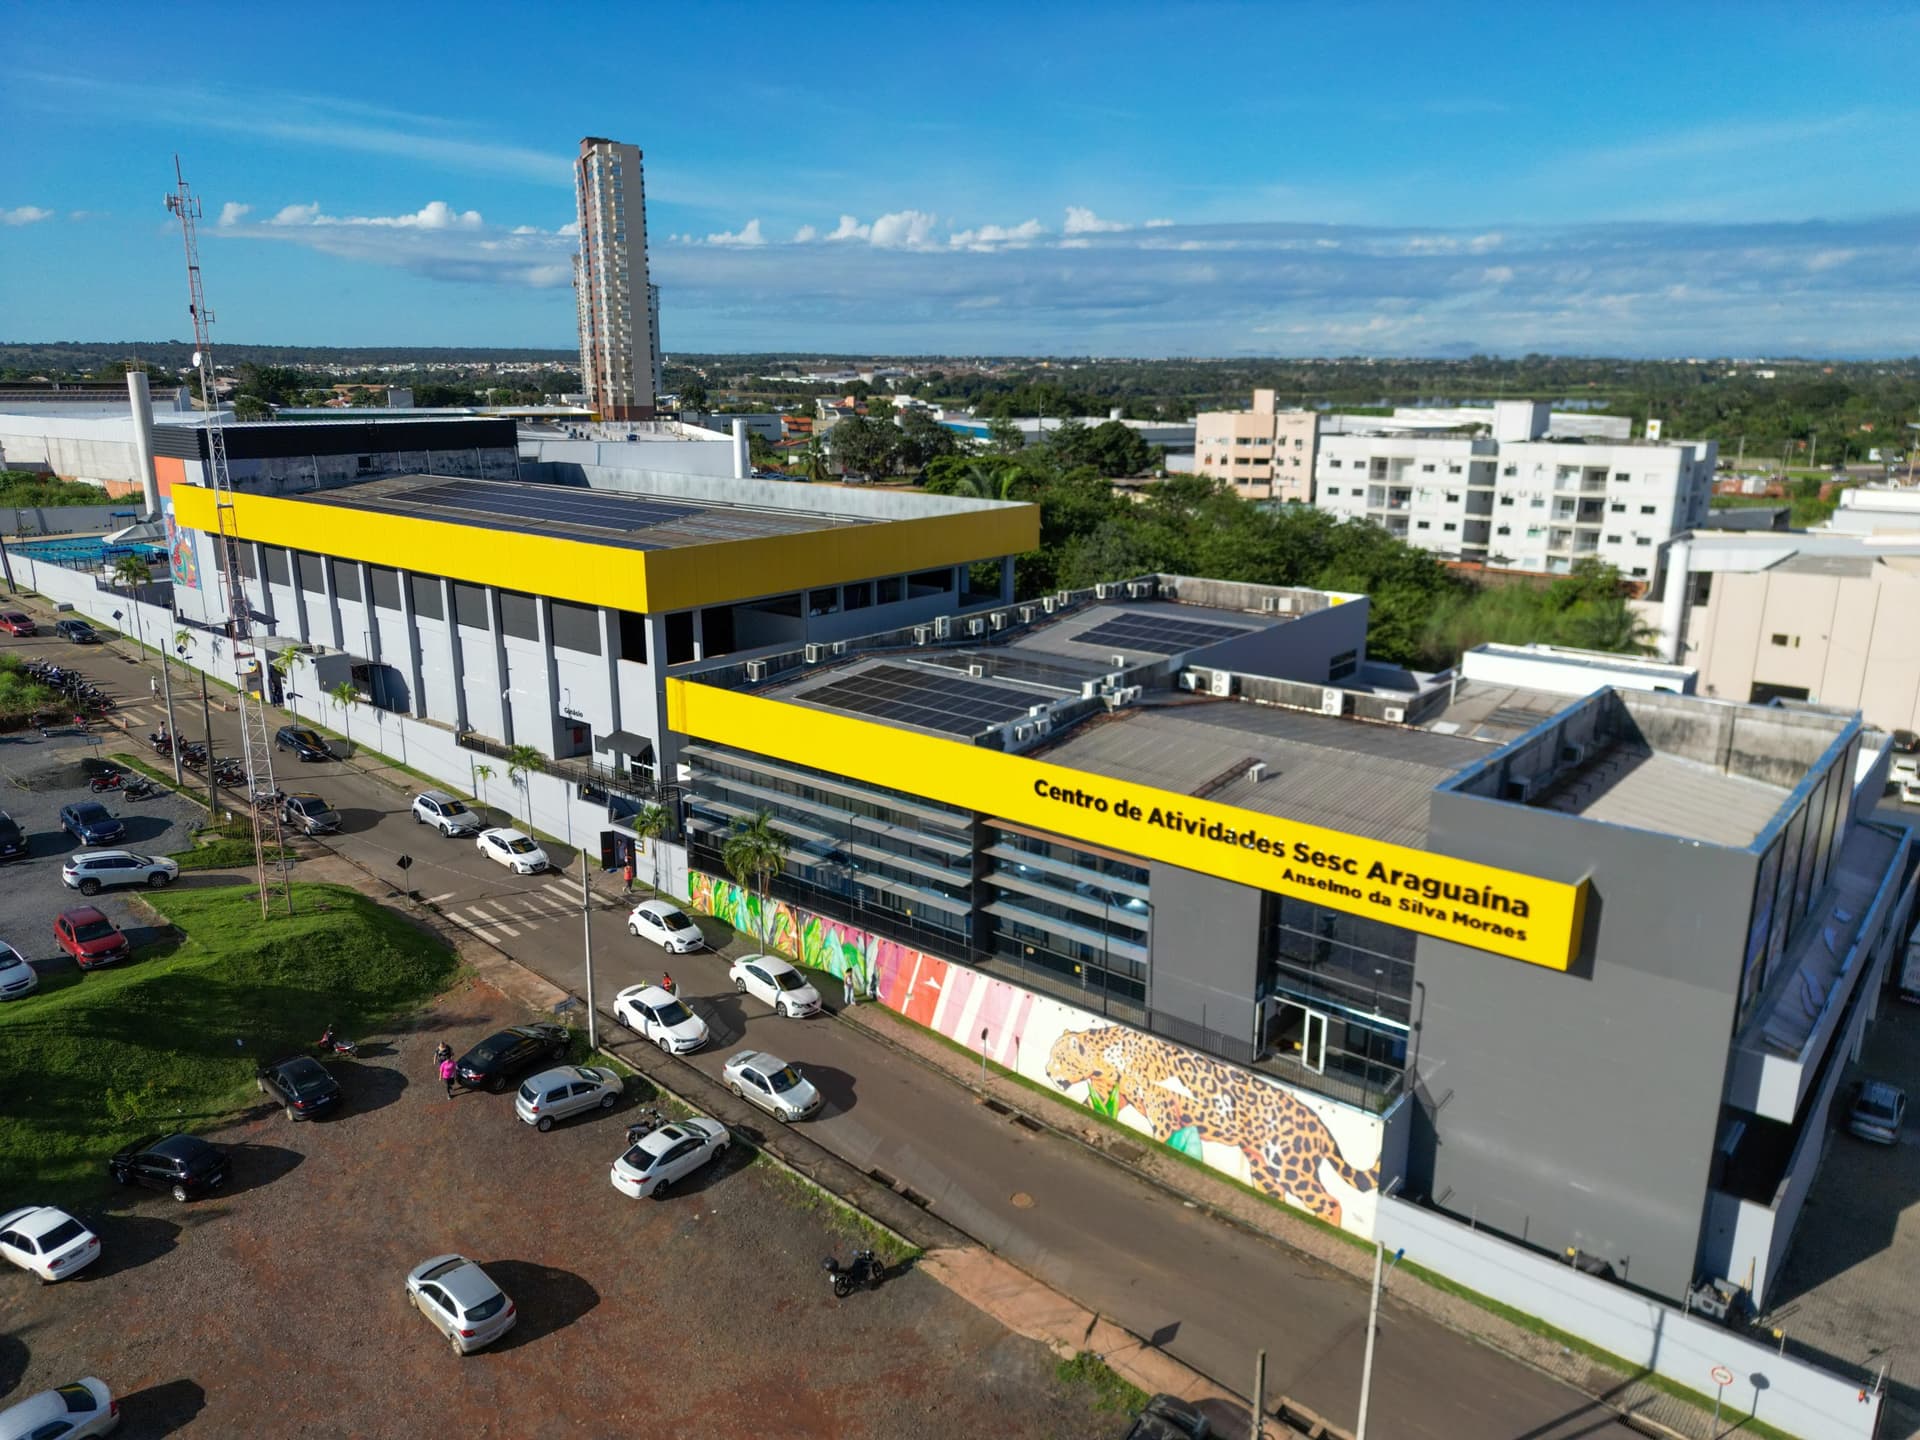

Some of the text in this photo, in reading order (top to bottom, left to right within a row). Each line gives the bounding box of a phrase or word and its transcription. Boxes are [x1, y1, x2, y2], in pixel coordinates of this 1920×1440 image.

[1033, 779, 1529, 918] Centro de Atividades Sesc Araguaína
[1282, 868, 1528, 941] Anselmo da Silva Moraes
